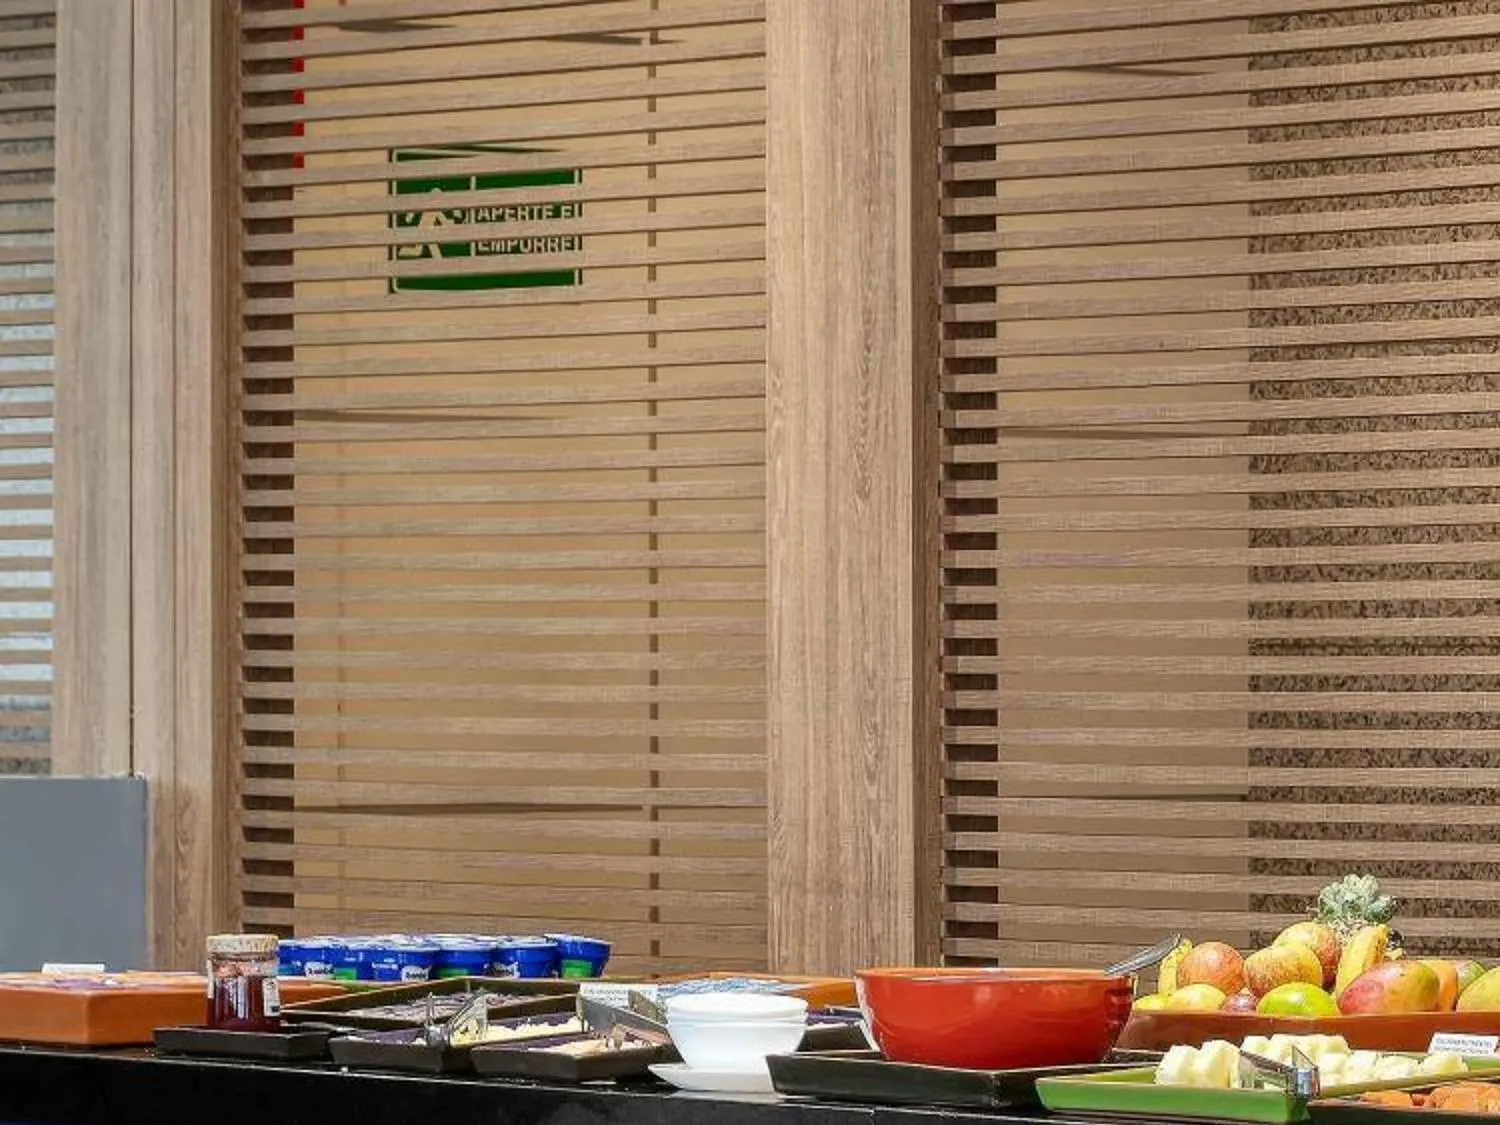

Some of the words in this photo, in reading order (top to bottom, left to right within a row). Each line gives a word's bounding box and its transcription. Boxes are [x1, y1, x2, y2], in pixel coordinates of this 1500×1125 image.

[477, 205, 553, 222] APERTE
[562, 204, 572, 219] E
[478, 237, 573, 253] EMPURRE
